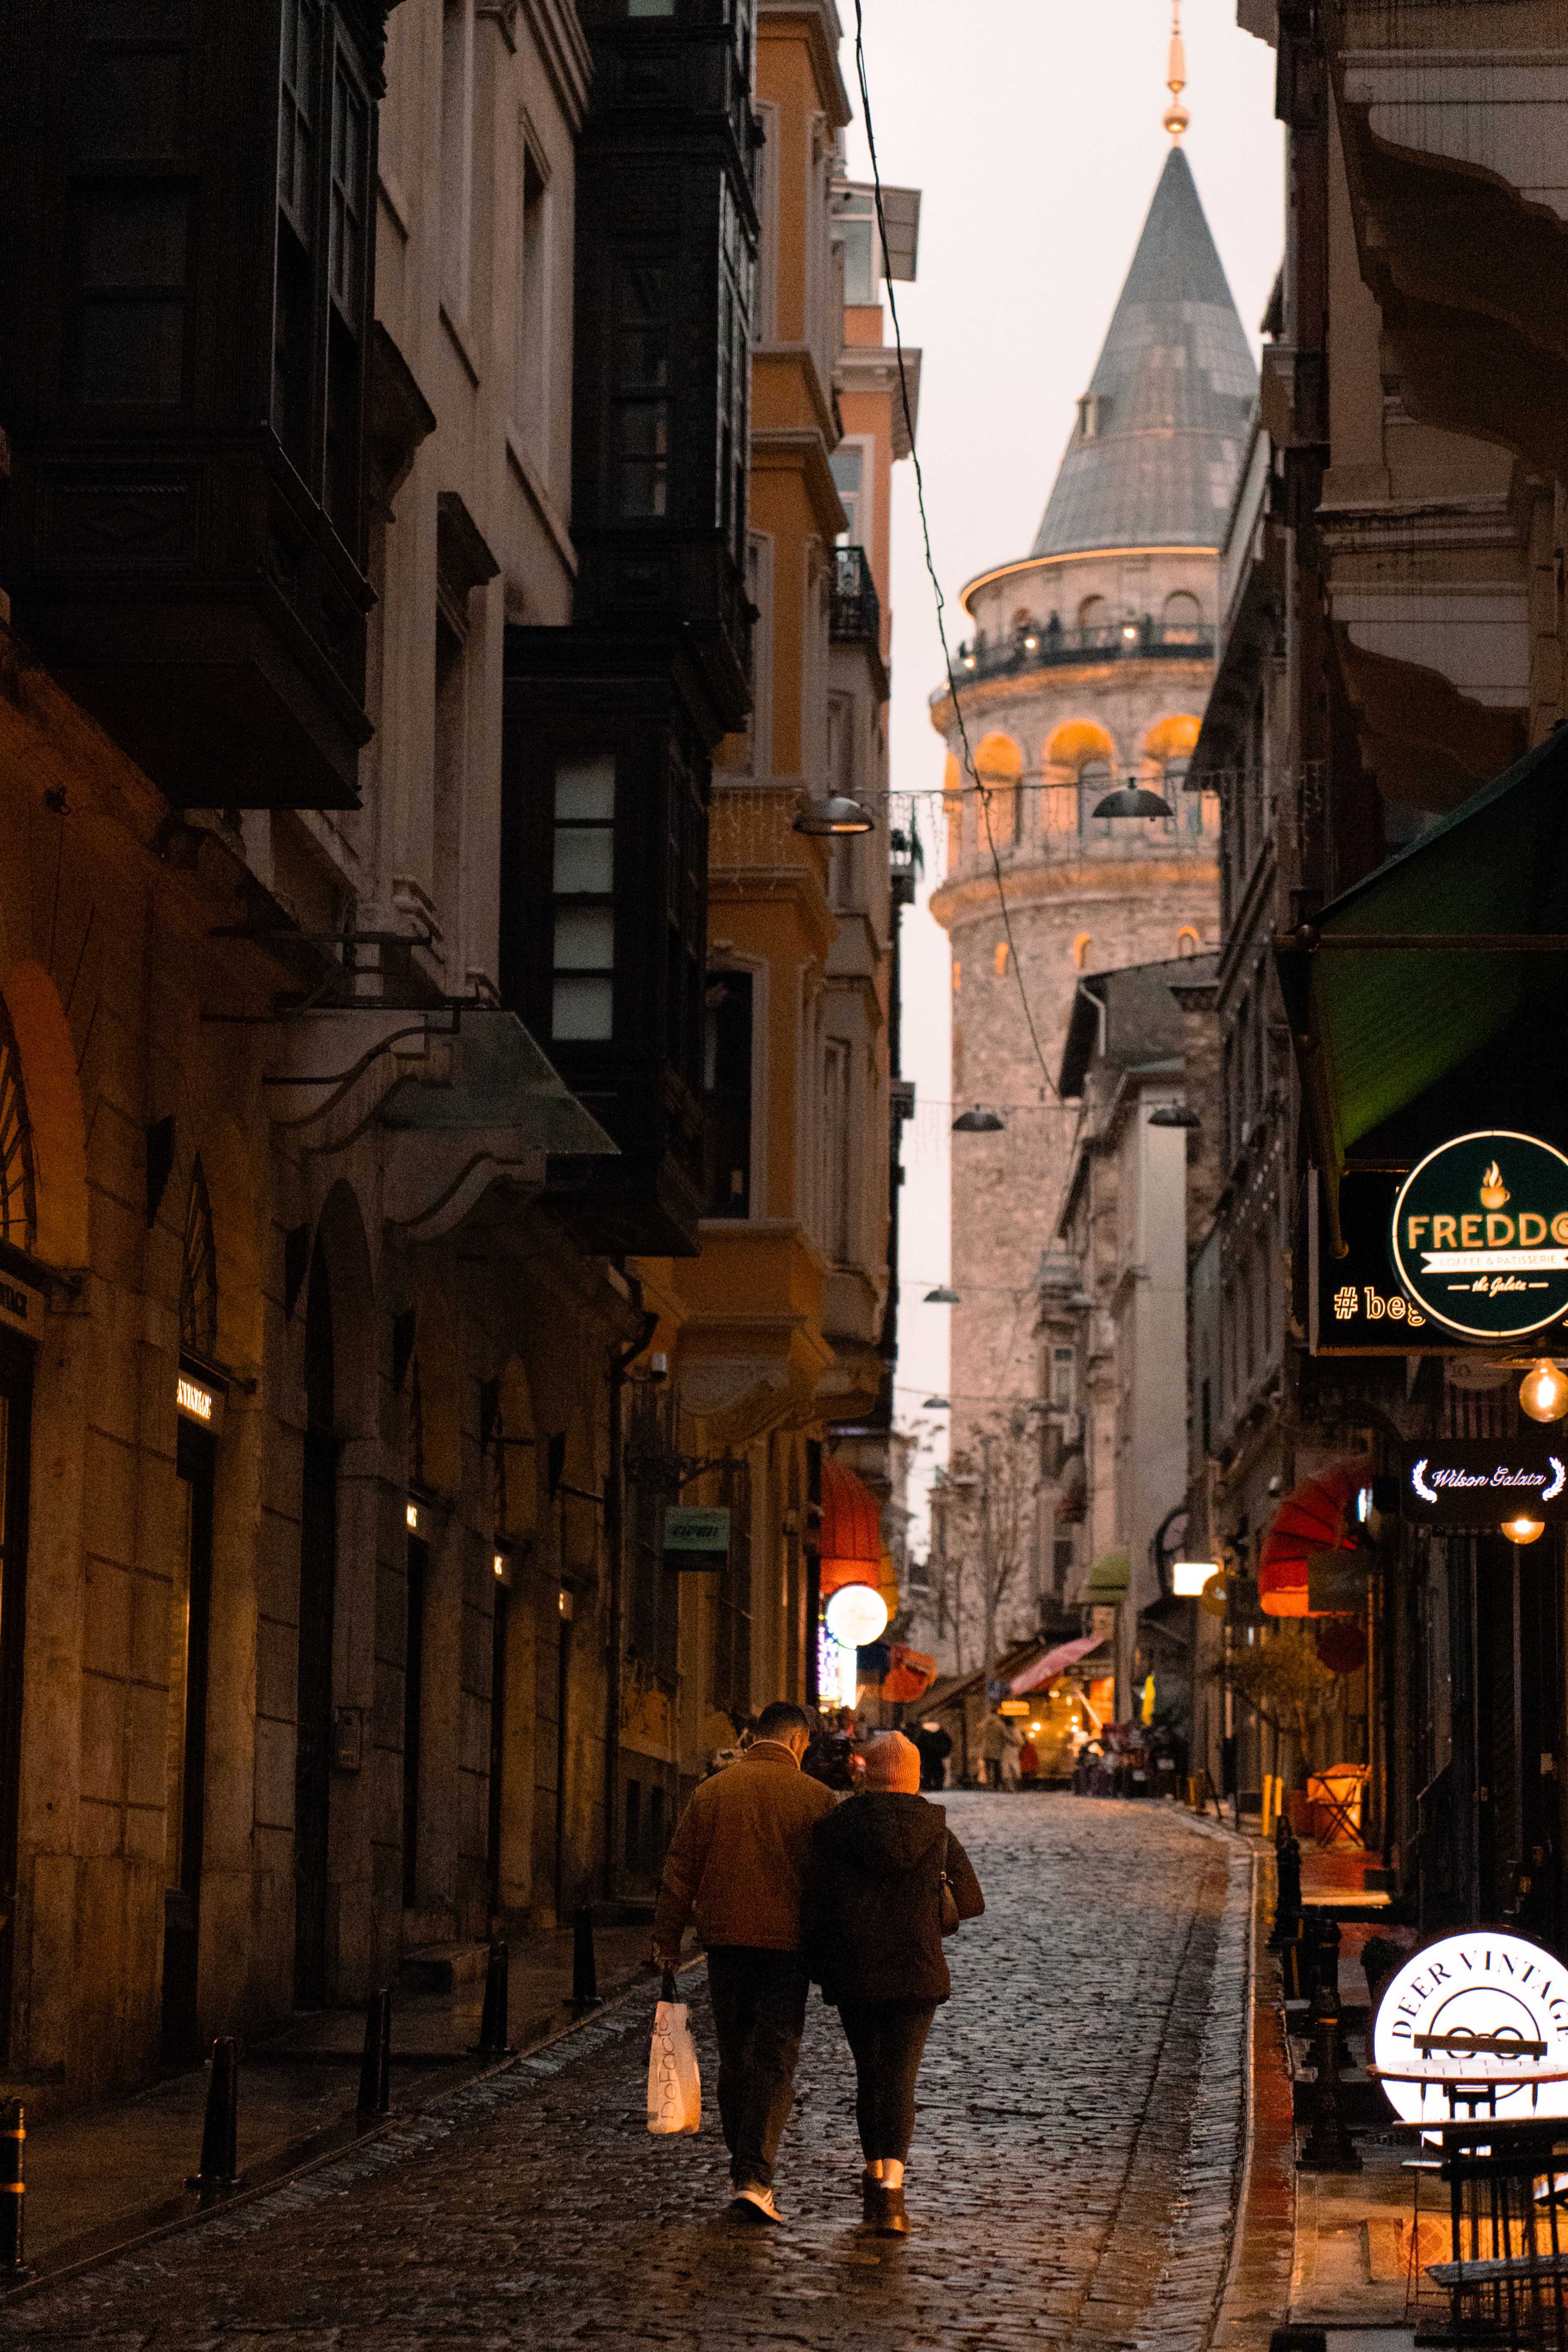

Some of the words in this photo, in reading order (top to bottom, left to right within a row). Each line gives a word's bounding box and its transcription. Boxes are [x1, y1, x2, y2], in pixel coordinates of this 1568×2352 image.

[1440, 1256, 1482, 1267] COFFEE
[1497, 1255, 1557, 1265] PATISSERIE
[1432, 1469, 1489, 1487] Wilson
[1489, 1466, 1546, 1486] Galata
[1392, 1962, 1452, 2039] DEER
[658, 2014, 676, 2119] DeFacto
